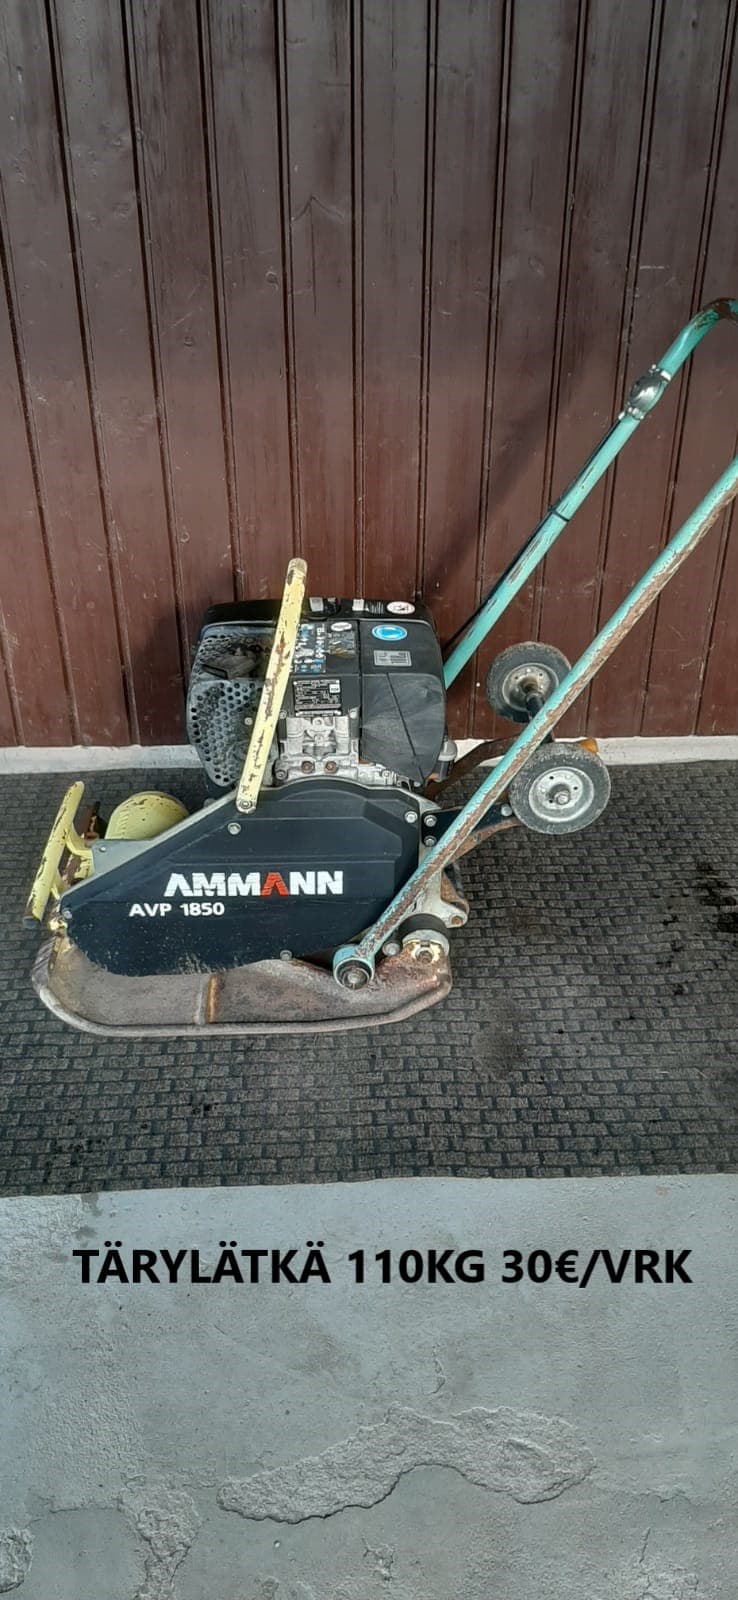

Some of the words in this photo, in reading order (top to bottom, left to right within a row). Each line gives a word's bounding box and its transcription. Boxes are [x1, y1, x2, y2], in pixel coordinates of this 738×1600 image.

[163, 870, 344, 898] AMMANN
[128, 903, 172, 918] AVP
[180, 902, 225, 917] 1850
